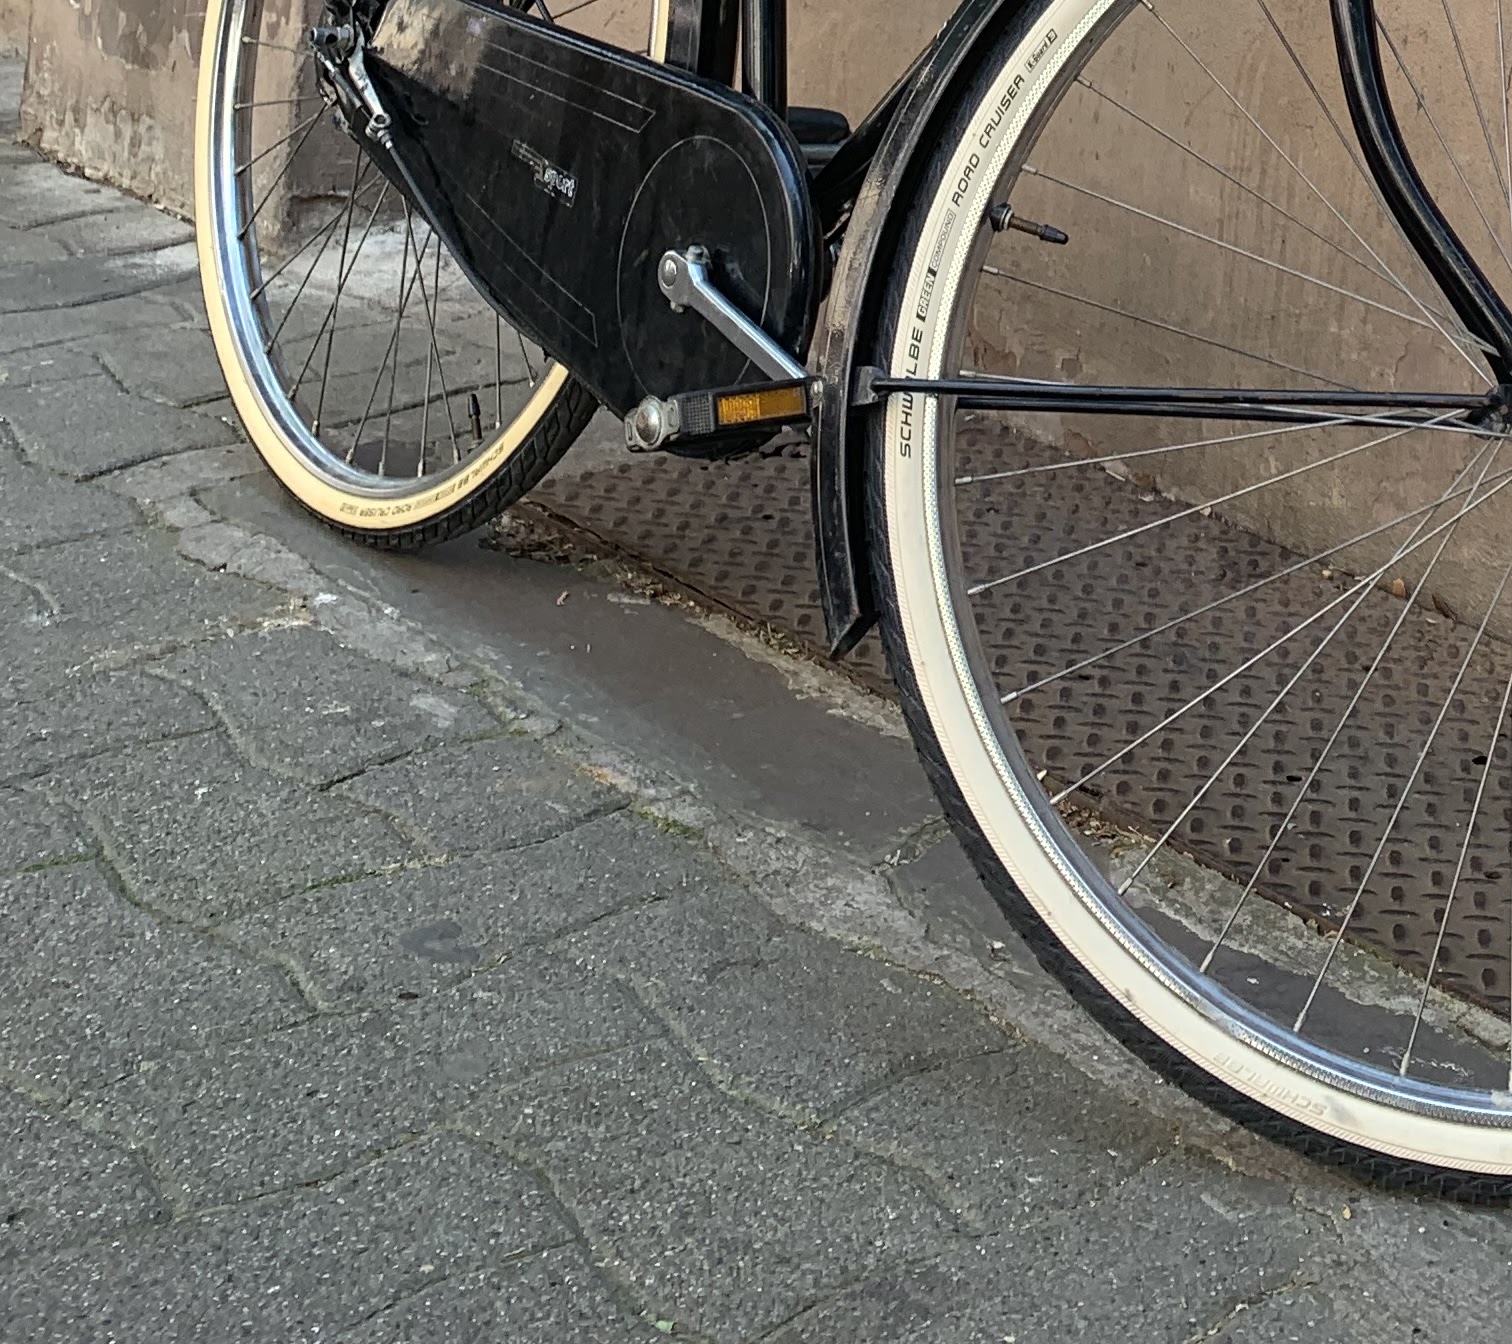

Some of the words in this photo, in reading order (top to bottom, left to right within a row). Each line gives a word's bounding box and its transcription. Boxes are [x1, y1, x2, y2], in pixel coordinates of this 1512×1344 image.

[899, 328, 924, 459] SCHWLBE
[951, 153, 981, 208] ROAD
[979, 73, 1026, 148] CRUISER
